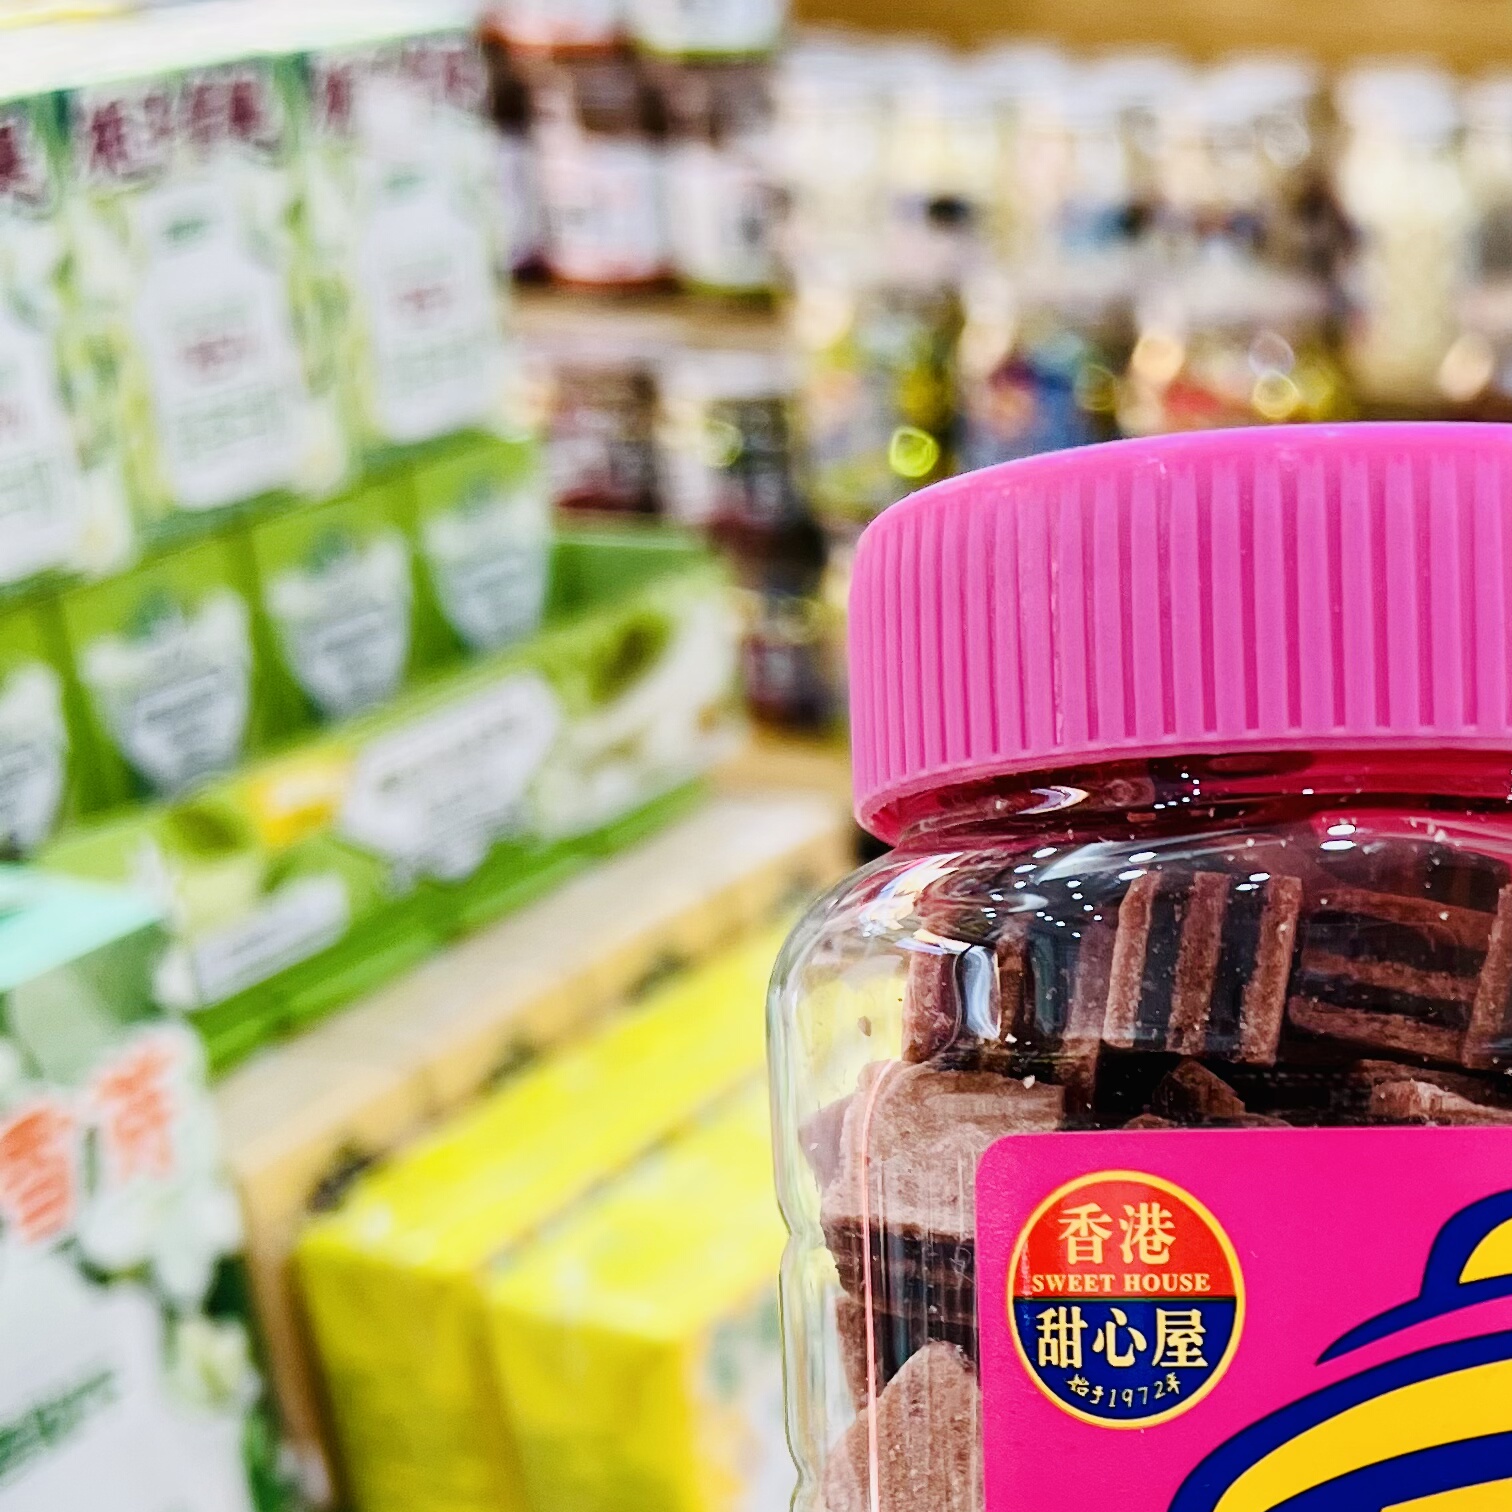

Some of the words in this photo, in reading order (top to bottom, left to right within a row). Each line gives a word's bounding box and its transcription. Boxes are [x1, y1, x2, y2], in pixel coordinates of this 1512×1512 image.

[1057, 1202, 1176, 1265] 香港
[1031, 1273, 1115, 1293] SWEET
[1123, 1273, 1211, 1292] HOUSE
[1035, 1305, 1208, 1368] 甜心屋
